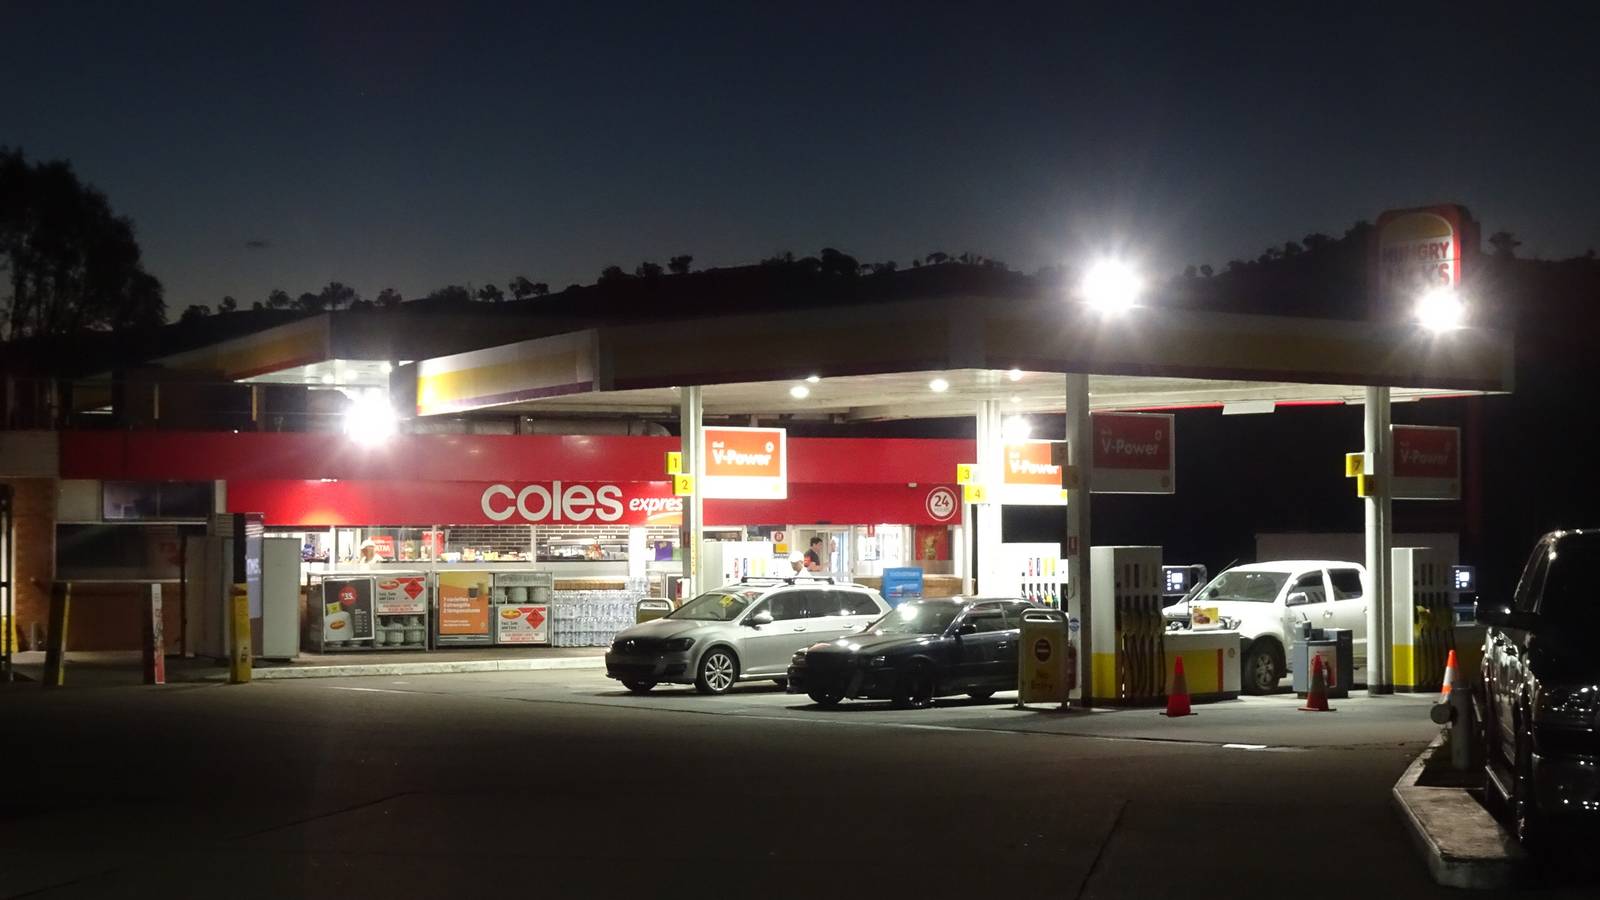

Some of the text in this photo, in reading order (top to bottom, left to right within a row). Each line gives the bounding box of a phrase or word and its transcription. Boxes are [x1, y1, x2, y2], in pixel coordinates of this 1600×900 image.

[1102, 438, 1160, 456] V-Power
[673, 456, 679, 469] 1
[712, 448, 773, 466] V-Power
[1400, 448, 1449, 465] V-Power
[964, 469, 971, 480] 3
[681, 479, 689, 490] 2
[974, 488, 982, 498] 4
[481, 480, 683, 522] coles expres
[934, 494, 950, 507] 24
